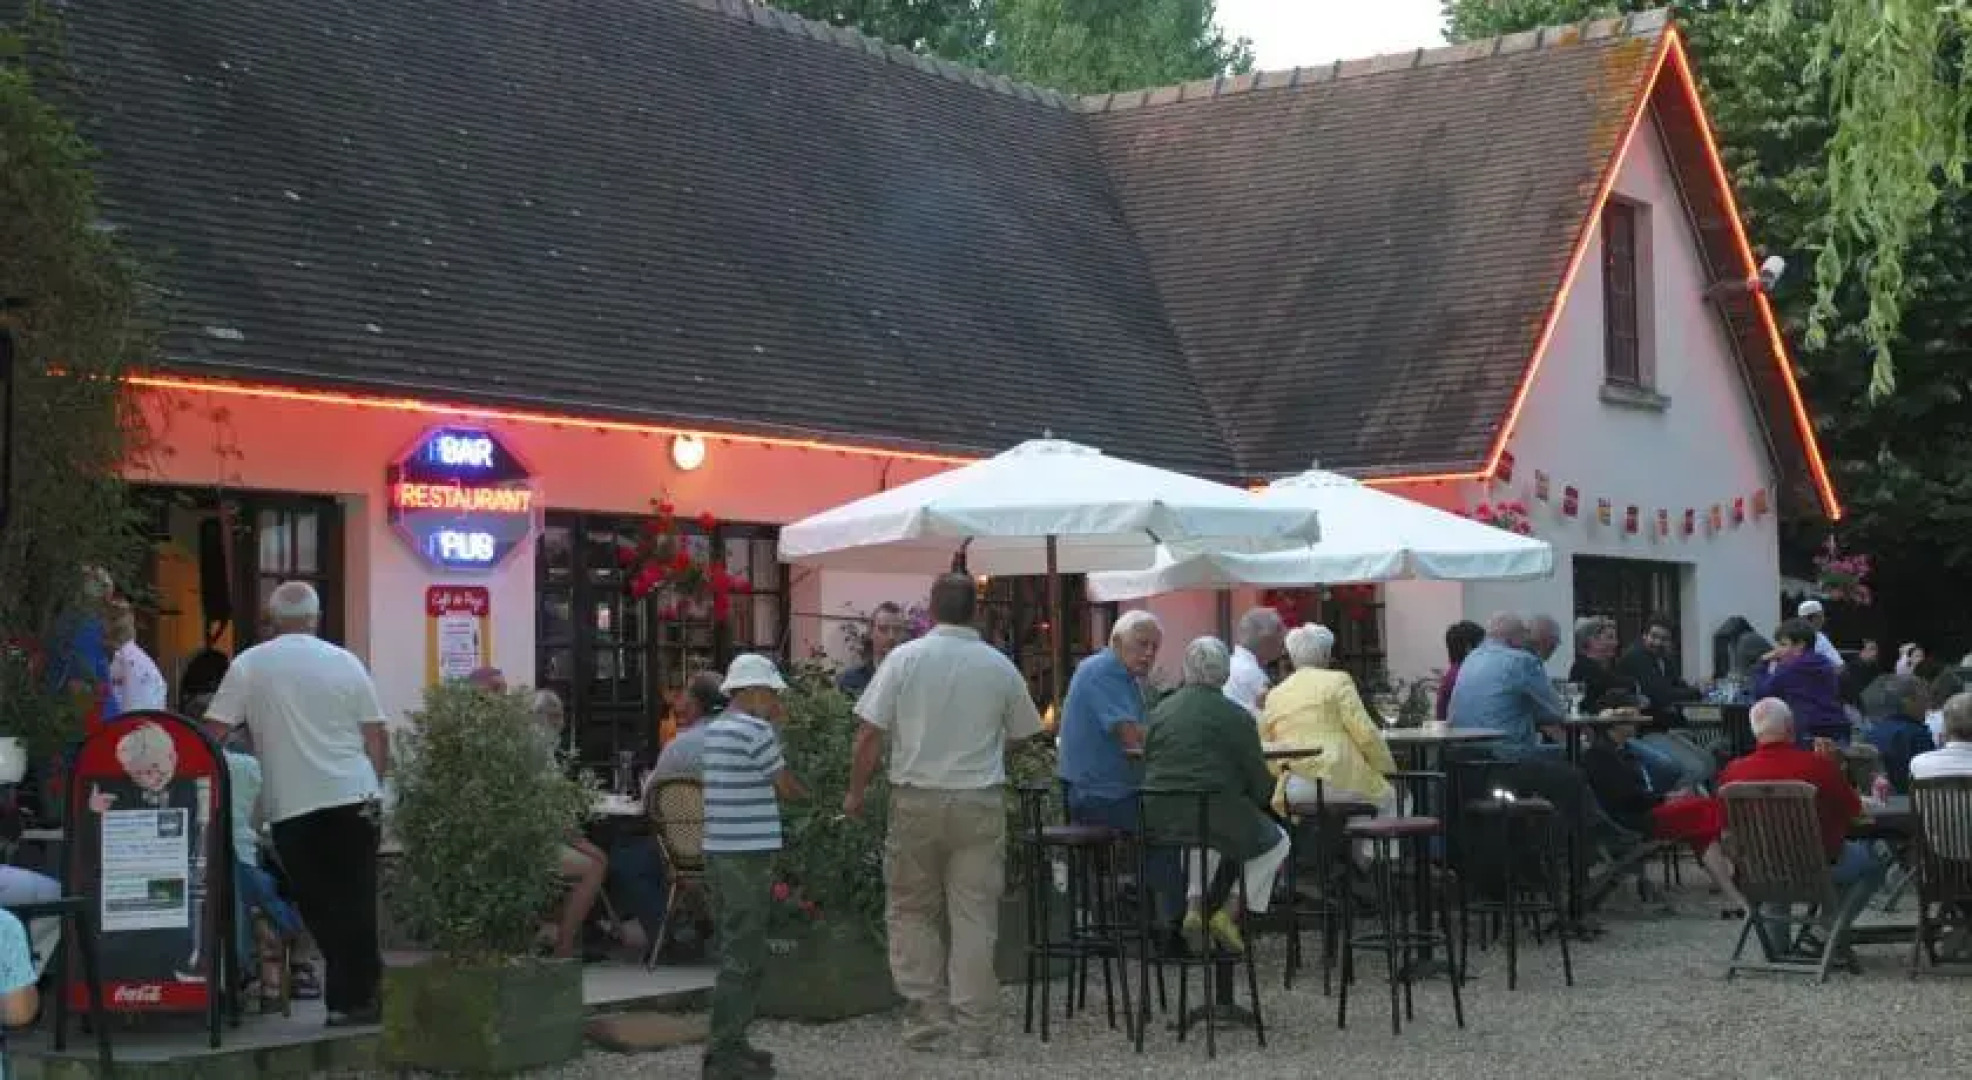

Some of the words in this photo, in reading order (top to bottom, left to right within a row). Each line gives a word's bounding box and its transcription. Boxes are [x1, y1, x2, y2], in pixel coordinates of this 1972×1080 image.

[440, 436, 495, 468] BAR
[400, 484, 532, 513] RESTAURANT
[440, 531, 495, 562] PUB
